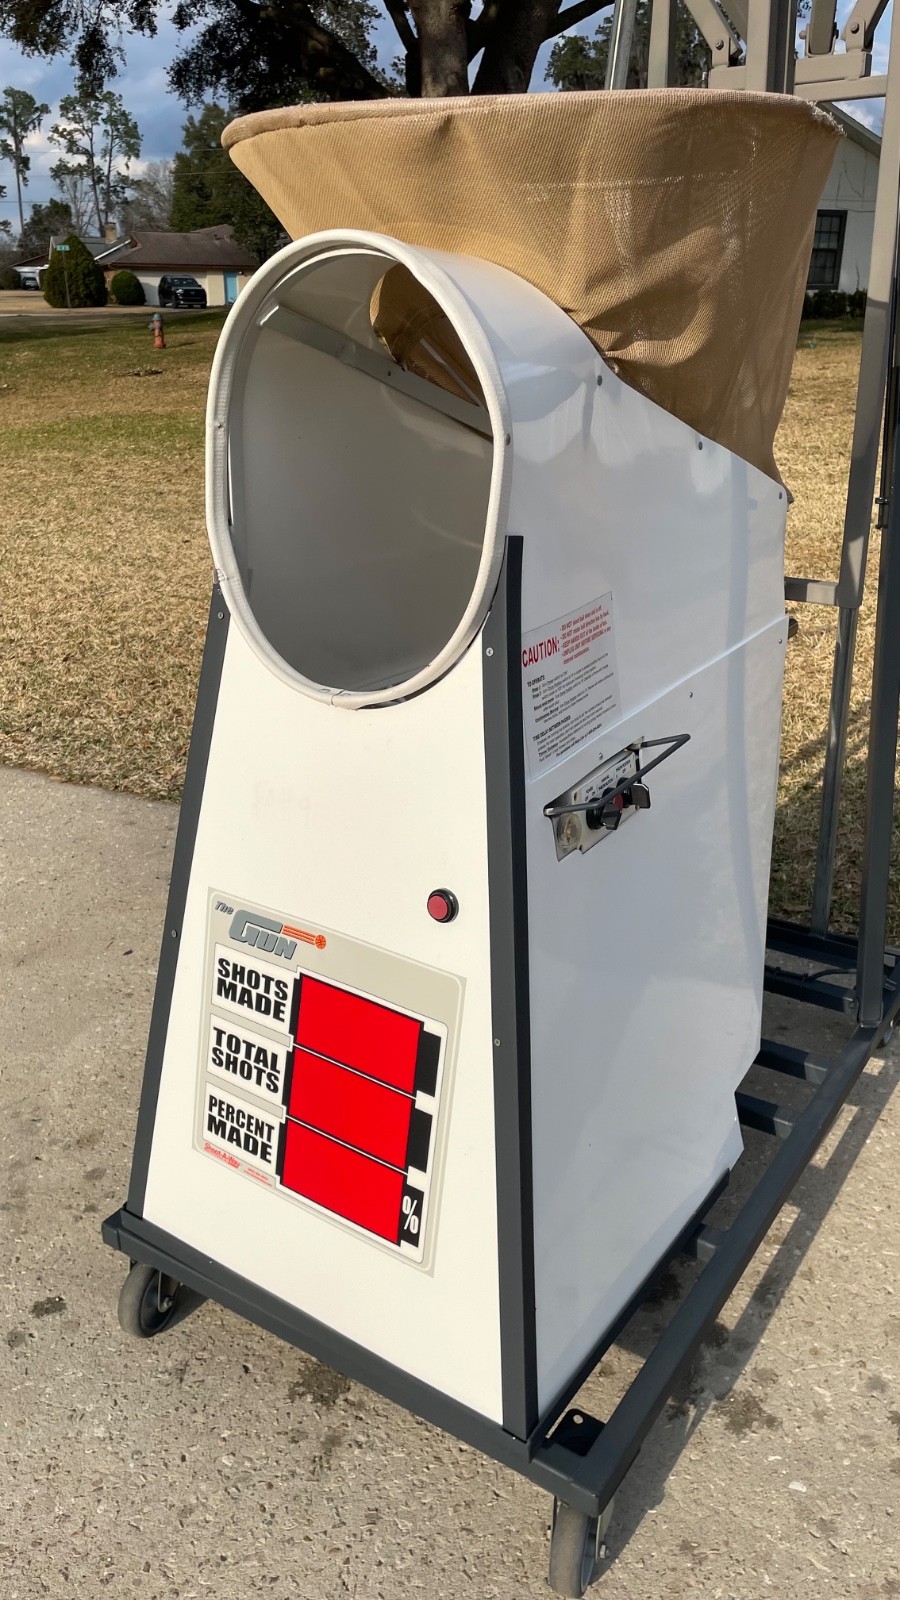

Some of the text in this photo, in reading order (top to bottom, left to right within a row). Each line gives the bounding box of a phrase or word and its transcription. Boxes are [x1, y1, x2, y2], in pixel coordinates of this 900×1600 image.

[522, 636, 560, 668] CAUTION:
[215, 901, 234, 915] The
[229, 909, 297, 960] GUN
[217, 957, 289, 1001] SHOTS
[217, 976, 287, 1023] MADE
[211, 1046, 280, 1094] SHOTS
[213, 1026, 281, 1075] TOTAL
[207, 1112, 273, 1164] MADE
[208, 1094, 275, 1143] PERCENT
[402, 1195, 419, 1234] %
